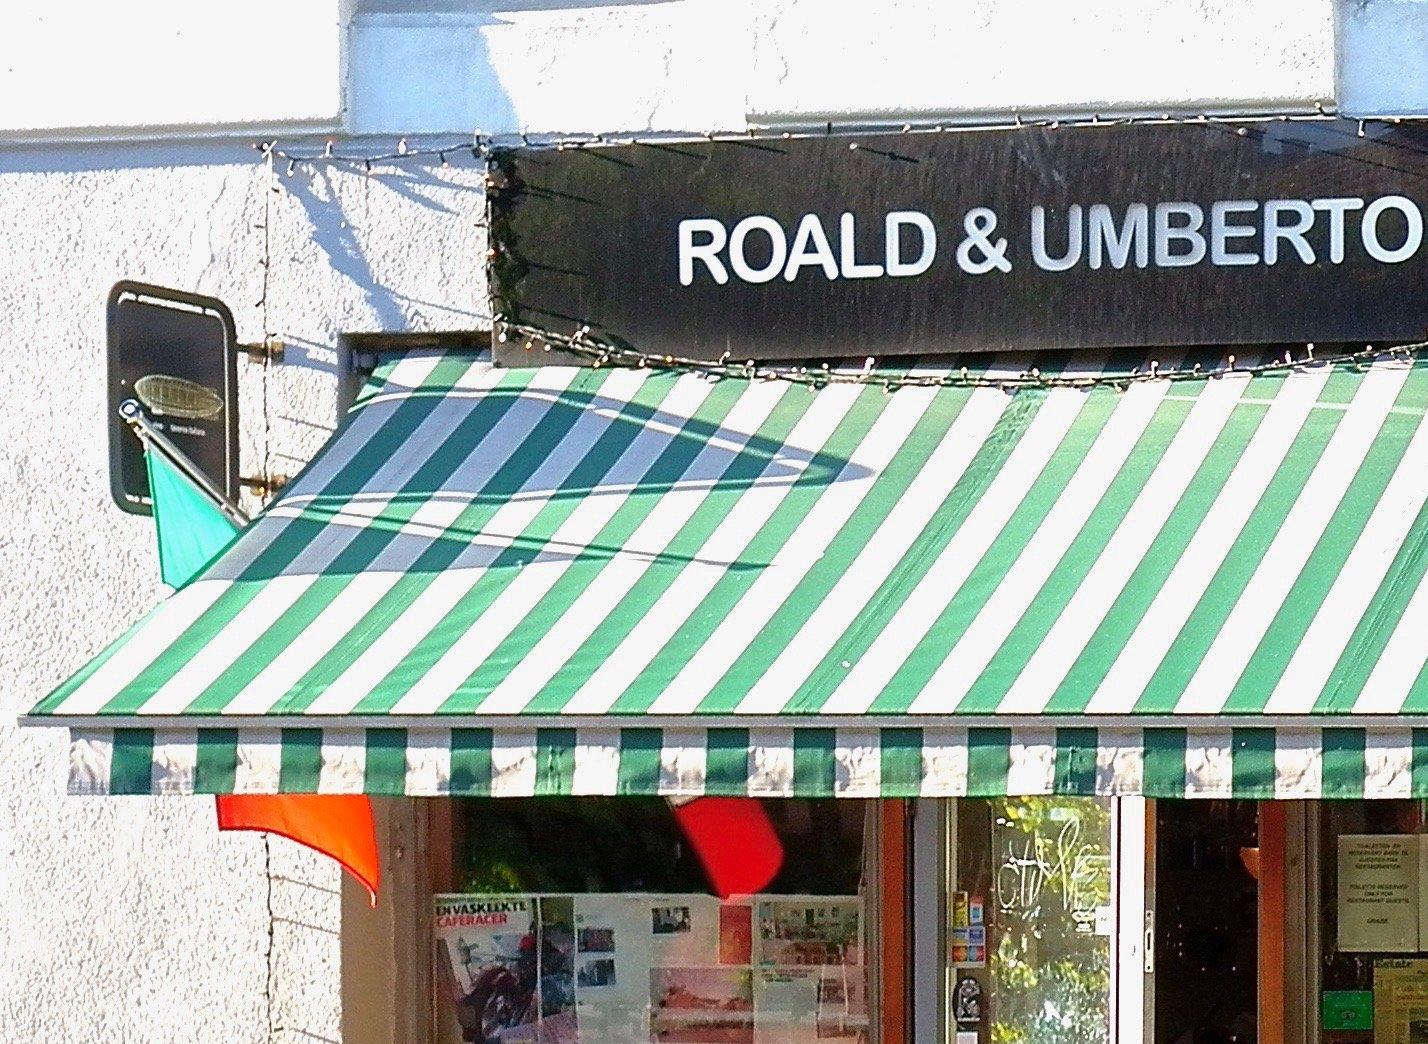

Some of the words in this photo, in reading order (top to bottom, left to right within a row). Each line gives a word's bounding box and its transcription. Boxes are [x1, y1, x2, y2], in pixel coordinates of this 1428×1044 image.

[677, 209, 938, 286] ROALD
[955, 205, 1014, 276] &
[1030, 194, 1425, 273] UMBERTO
